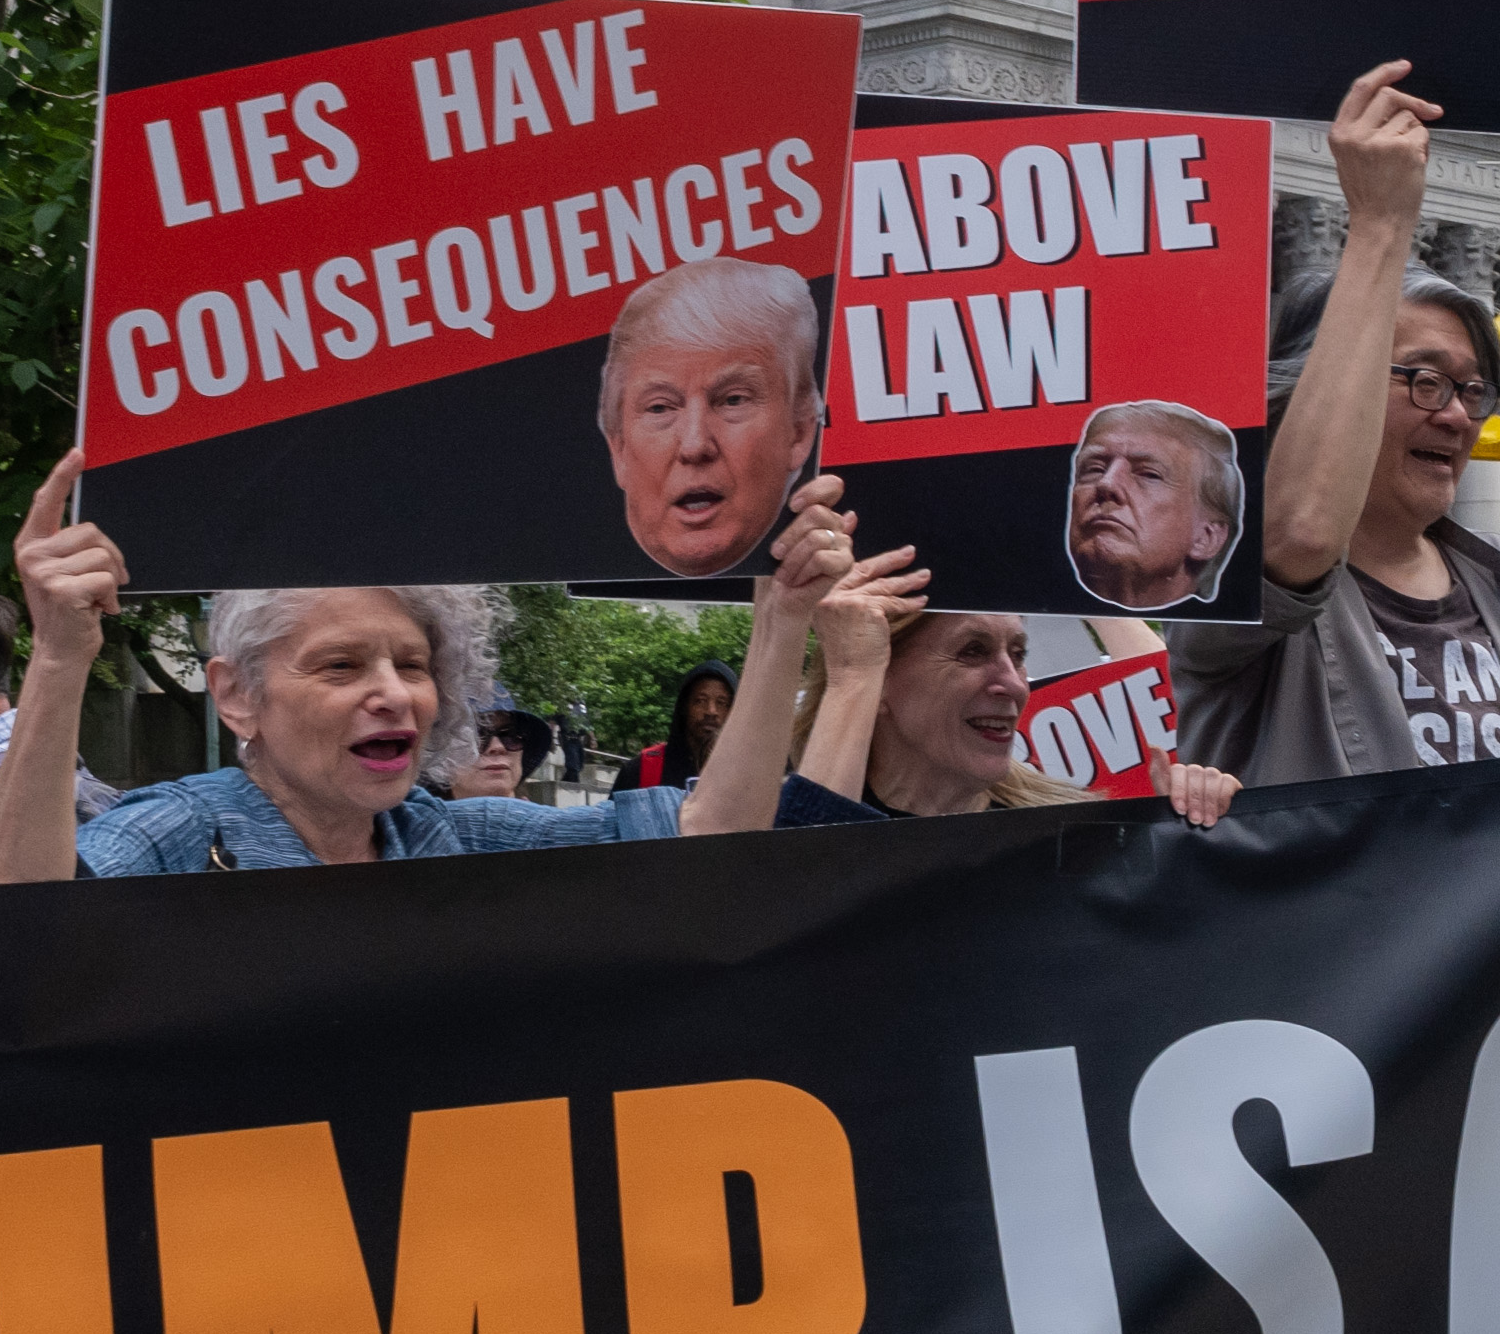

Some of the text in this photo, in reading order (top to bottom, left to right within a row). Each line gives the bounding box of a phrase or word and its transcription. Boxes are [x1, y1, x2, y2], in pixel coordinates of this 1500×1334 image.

[143, 8, 658, 229] LIES HAVE
[849, 134, 1217, 279] ABOVE
[106, 136, 825, 419] CONSEQUENCES
[844, 285, 1090, 424] LAW
